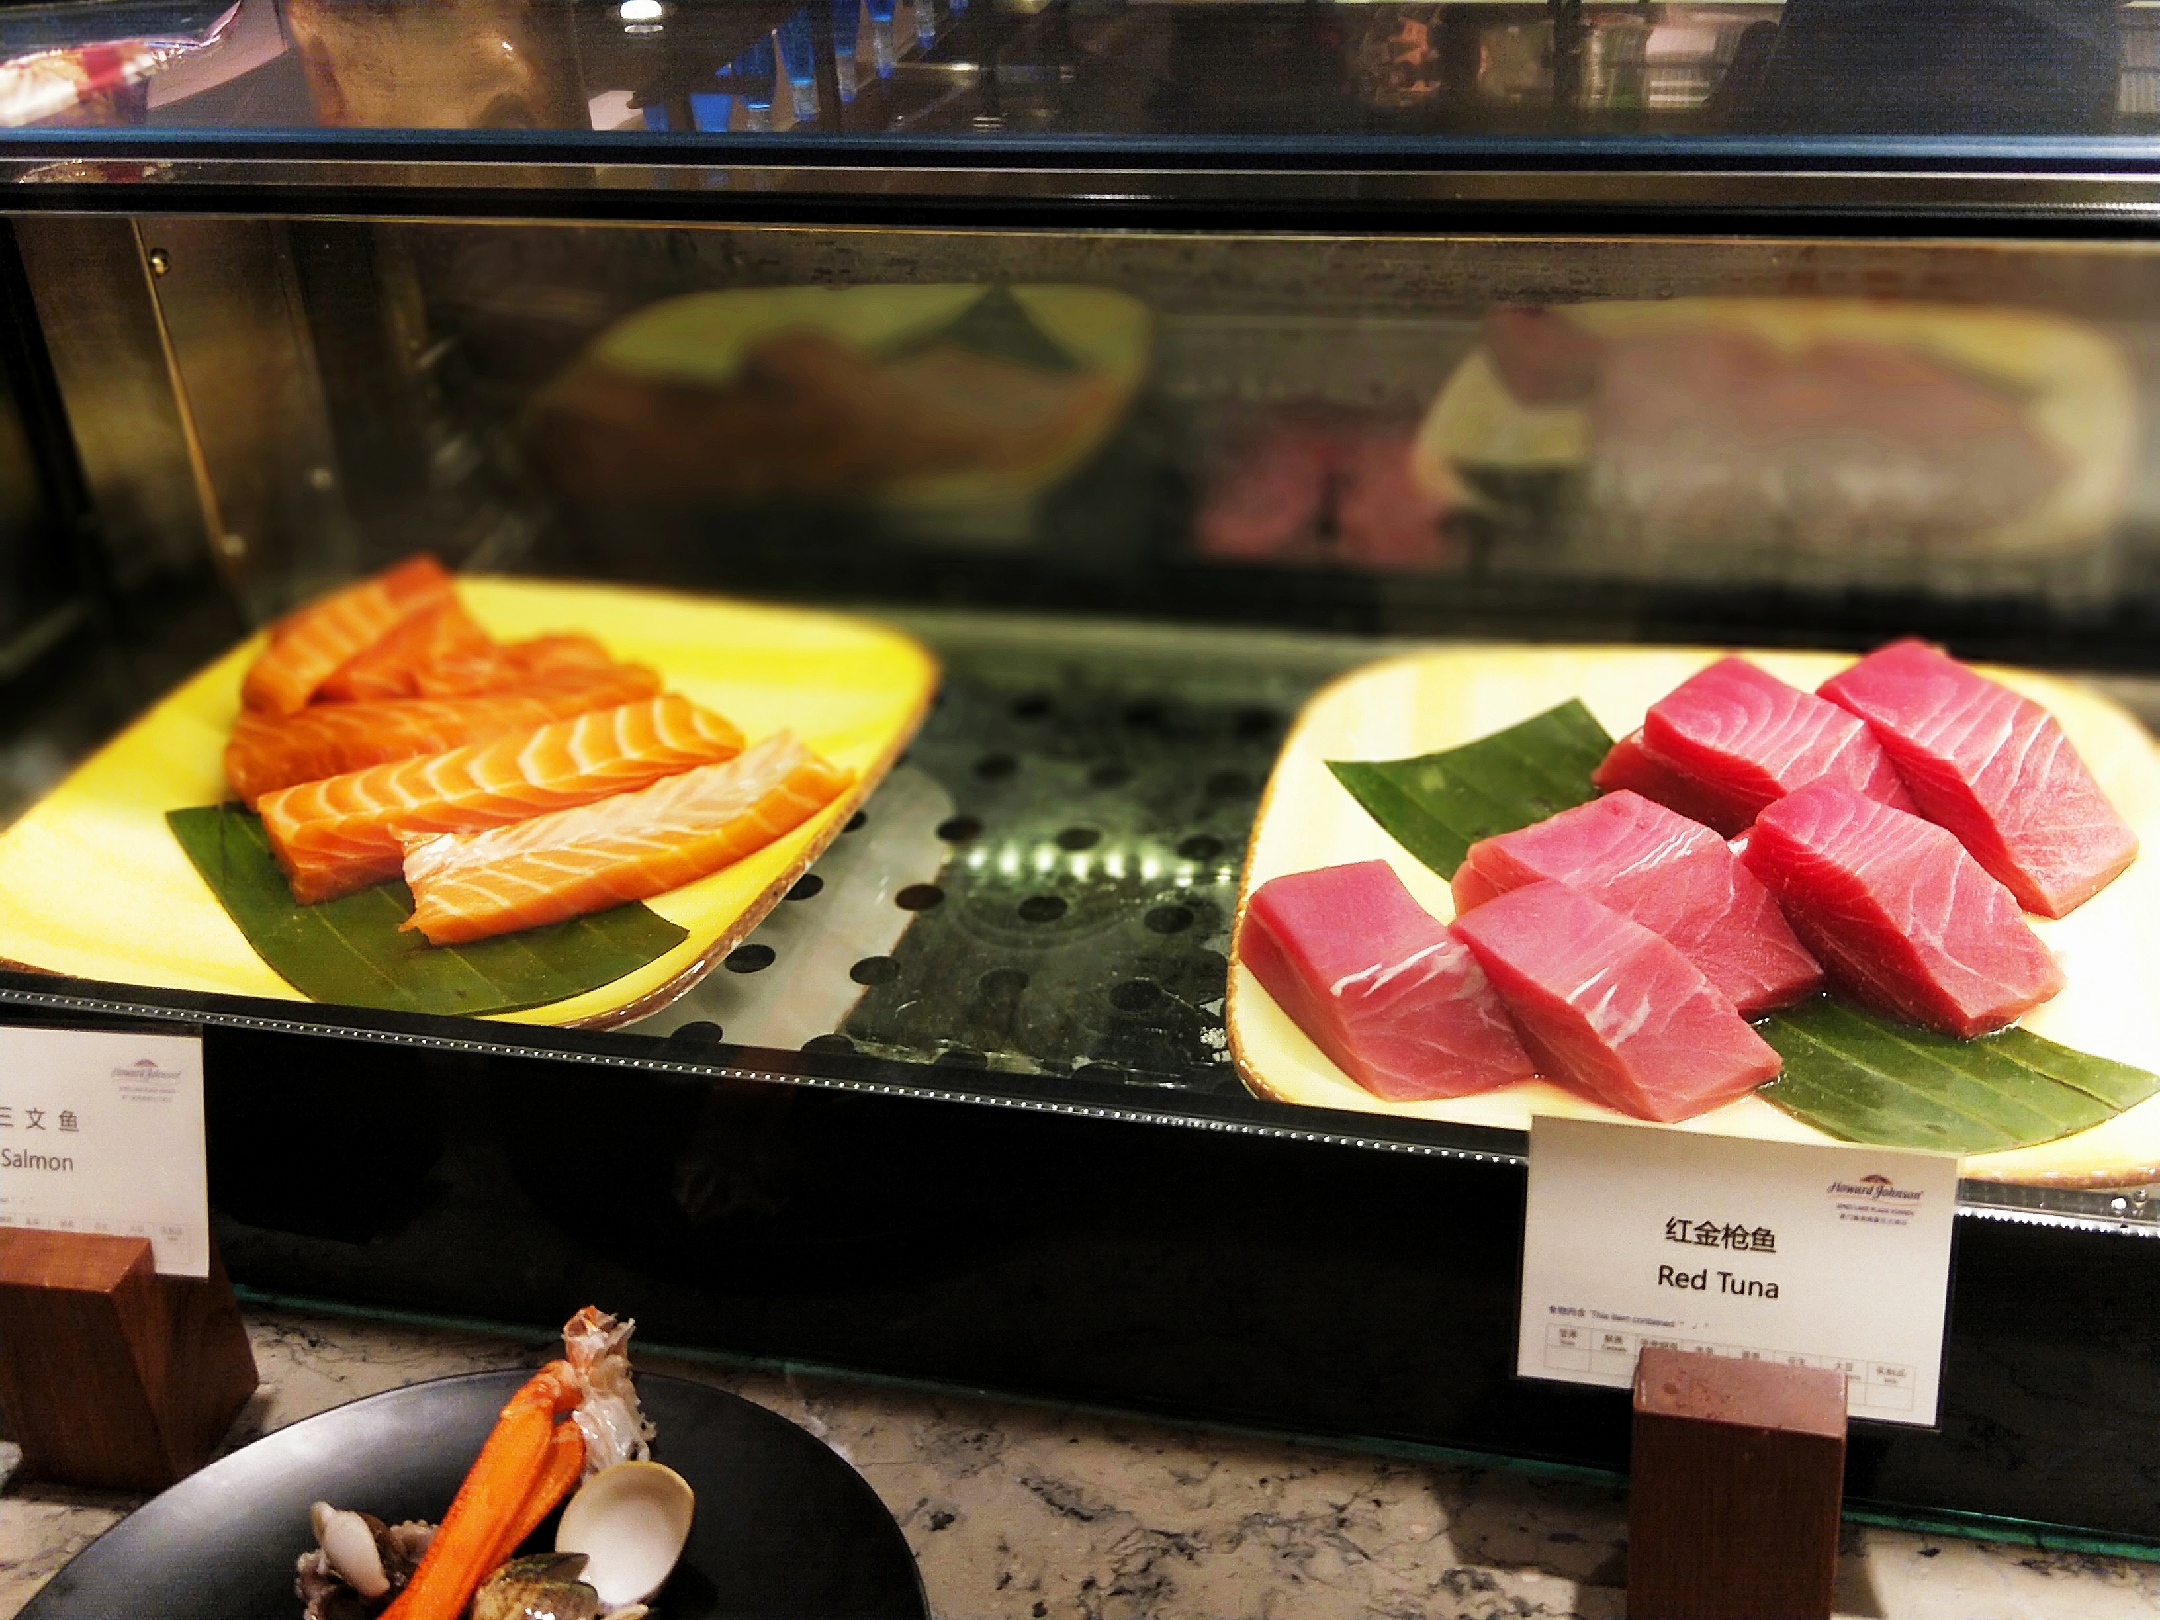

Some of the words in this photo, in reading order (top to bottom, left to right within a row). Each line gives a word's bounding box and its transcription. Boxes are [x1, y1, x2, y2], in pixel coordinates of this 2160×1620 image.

[0, 1106, 79, 1132] 三文鱼
[1, 1148, 74, 1171] Salmon
[1826, 1181, 1874, 1195] Howard
[1870, 1185, 1921, 1200] Johnson
[1665, 1216, 1777, 1253] 红金枪鱼
[1658, 1264, 1707, 1291] Red
[1717, 1271, 1779, 1299] Tuna
